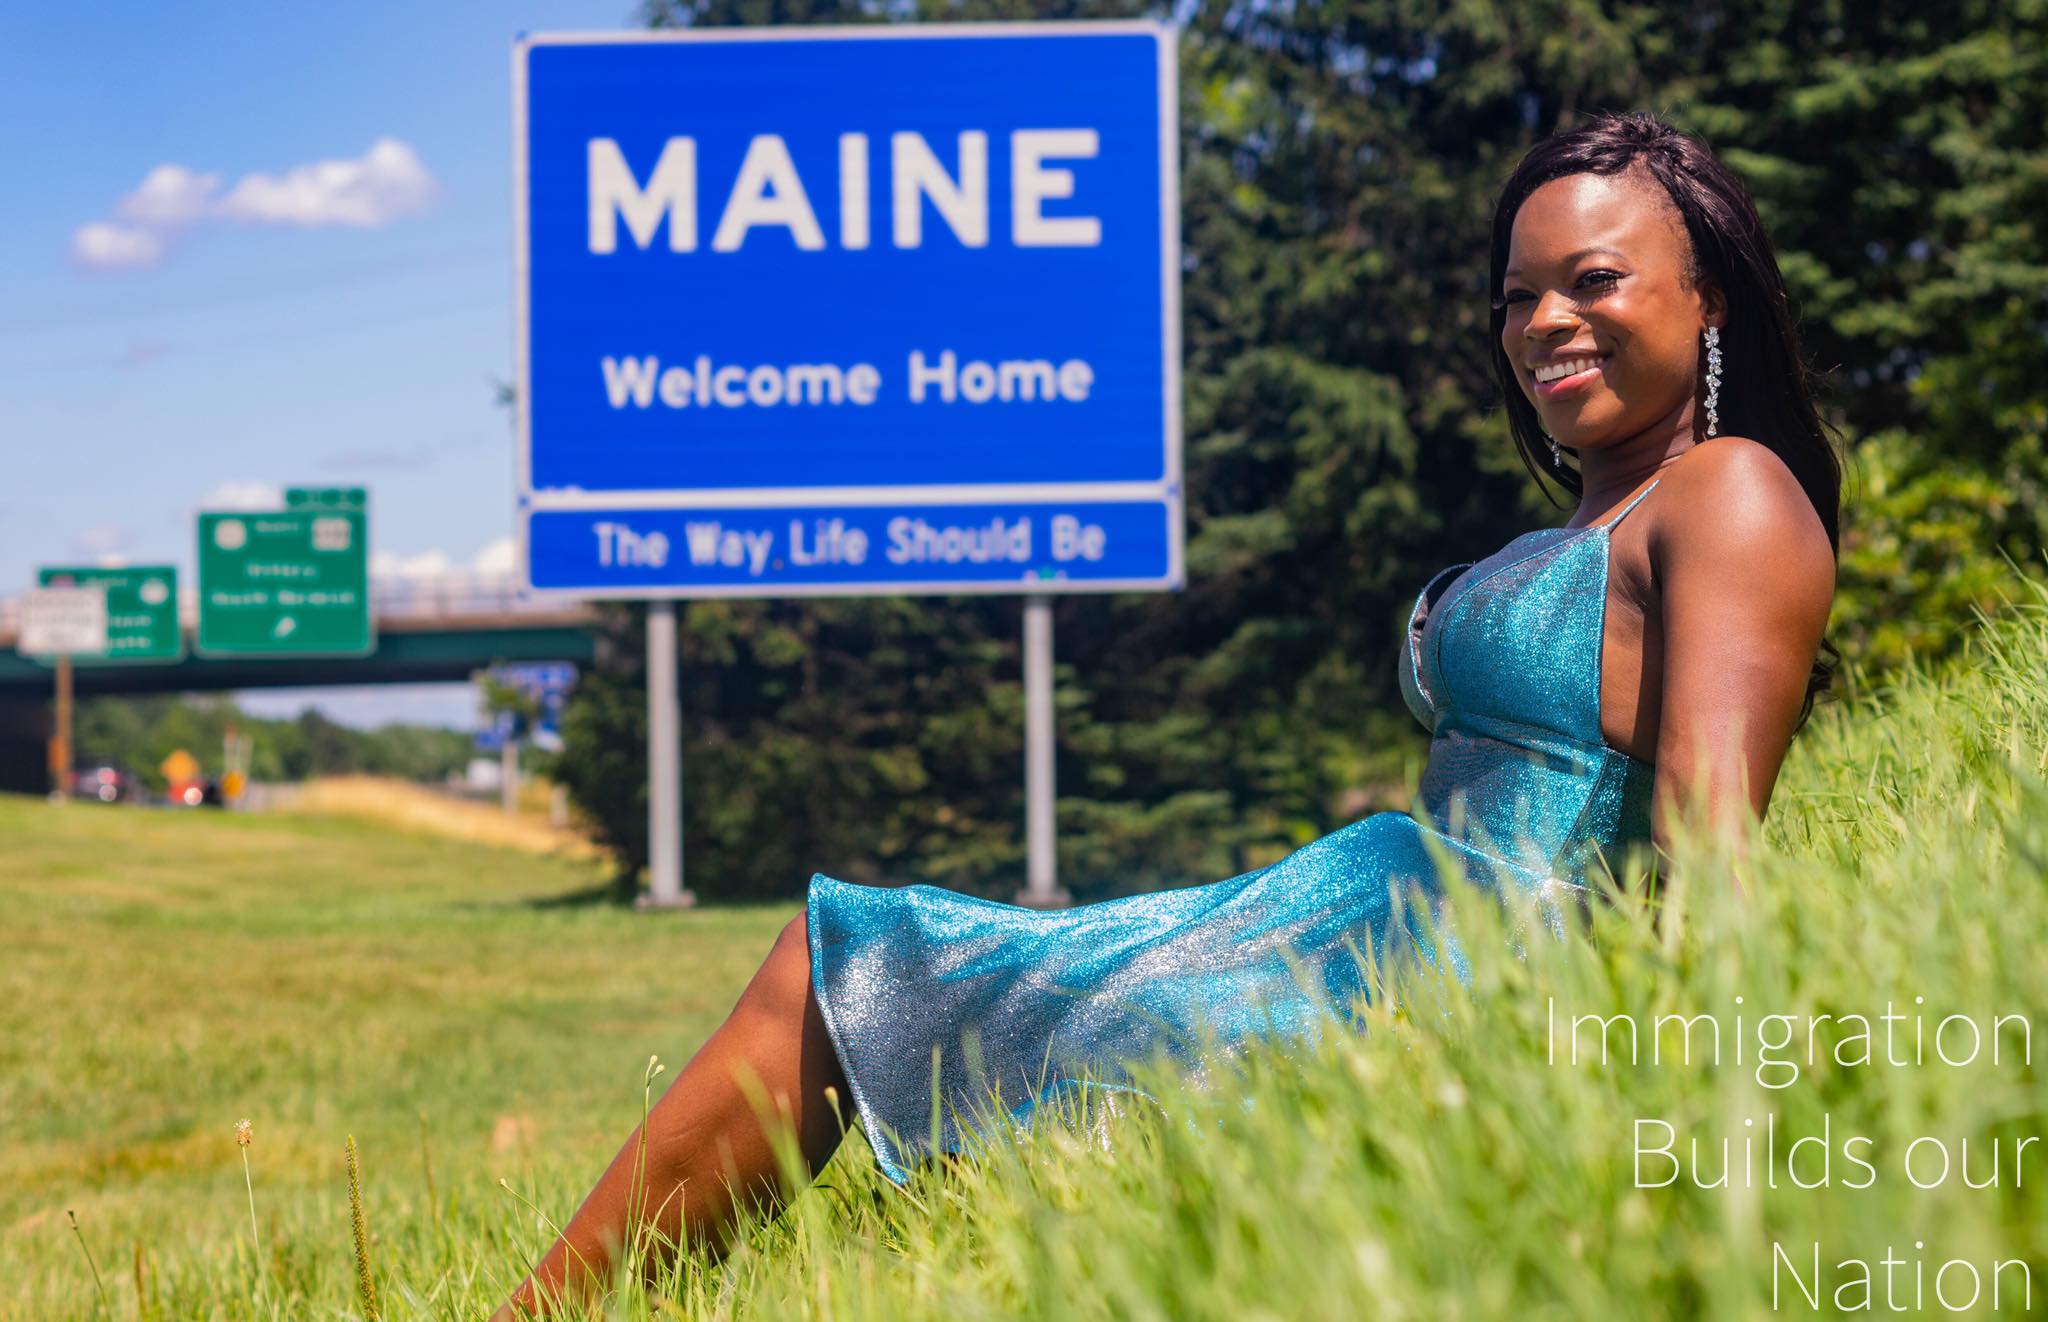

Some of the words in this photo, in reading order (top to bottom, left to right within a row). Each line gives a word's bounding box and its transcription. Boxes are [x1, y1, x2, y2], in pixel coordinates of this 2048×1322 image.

[587, 129, 1102, 255] MAINE
[601, 355, 881, 409] Welcome
[909, 350, 1095, 405] Home
[592, 522, 670, 567] The
[685, 521, 772, 575] Way
[790, 519, 868, 566] Life
[887, 517, 1032, 563] Should
[1051, 514, 1106, 560] Be
